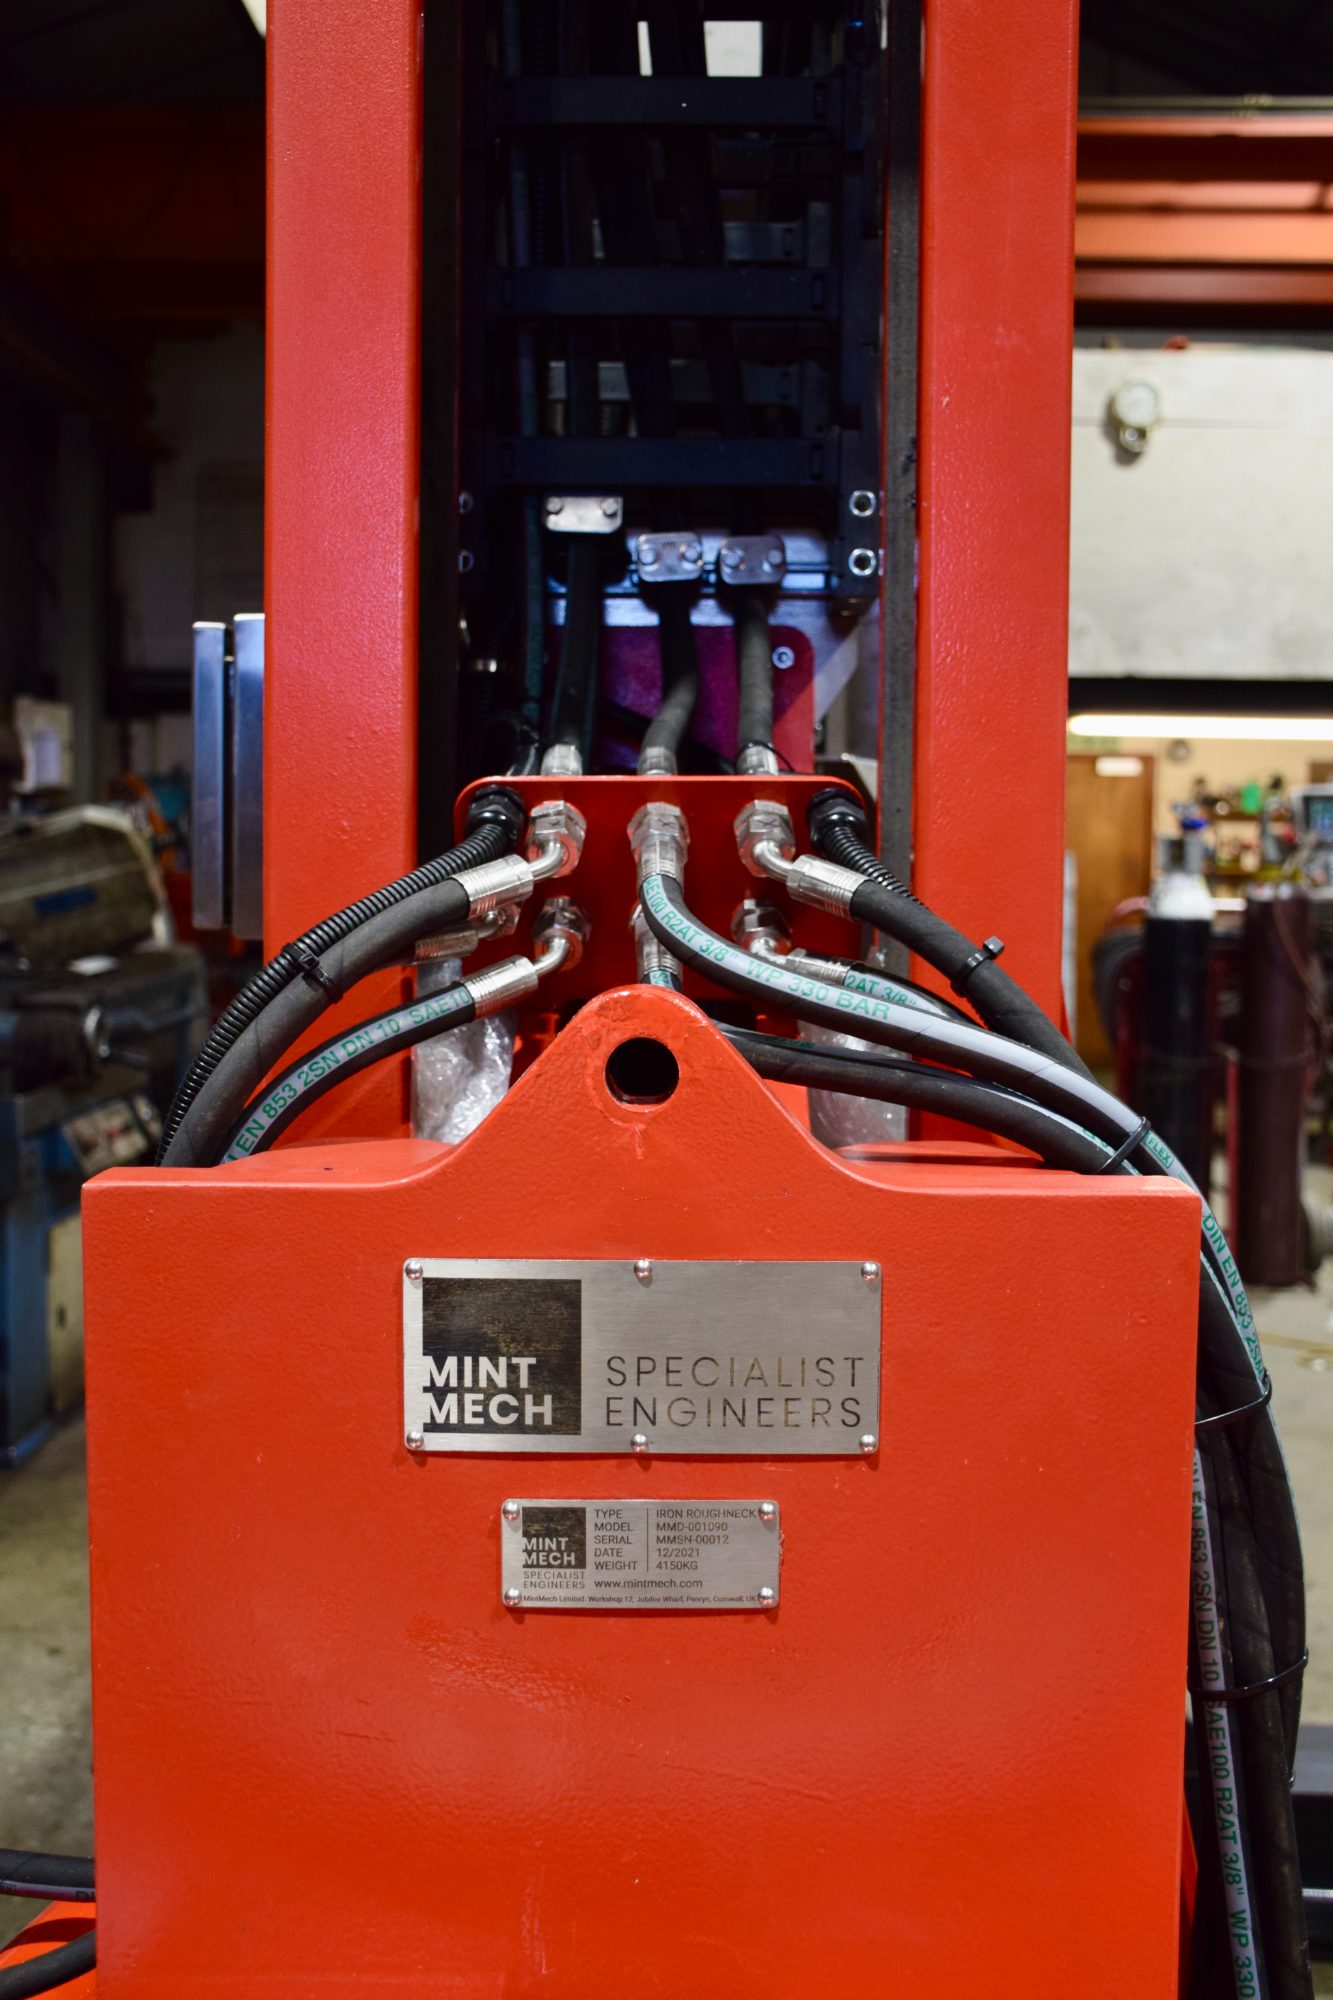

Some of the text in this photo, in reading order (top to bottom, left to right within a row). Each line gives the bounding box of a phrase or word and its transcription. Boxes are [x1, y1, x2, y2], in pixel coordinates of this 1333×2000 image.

[661, 911, 703, 943] R2AT
[745, 960, 784, 983] WP
[788, 977, 830, 1002] 330
[835, 991, 890, 1020] BAR
[235, 1119, 265, 1153] EN
[263, 1083, 297, 1118] 853
[297, 1051, 341, 1087] 2SN
[341, 1030, 374, 1057] DN
[376, 1018, 400, 1038] 10
[1147, 1137, 1171, 1164] FLEX
[1202, 1213, 1226, 1254] DIN
[1222, 1255, 1241, 1289] EN
[1235, 1290, 1253, 1330] 853
[423, 1356, 536, 1388] MINT
[606, 1356, 864, 1387] SPECIALIST
[423, 1394, 552, 1425] MECH
[606, 1397, 862, 1428] ENGINEERS
[594, 1508, 757, 1519] TYPE IRON ROUGHNECK
[594, 1521, 729, 1532] MODEL MMD-001090
[522, 1537, 569, 1550] MINT
[594, 1534, 730, 1545] SERIAL MMSN-00012
[594, 1547, 700, 1558] DATE 12/2021
[1191, 1527, 1208, 1563] 853
[522, 1552, 576, 1566] MECH
[594, 1560, 698, 1571] WEIGHT 4150KG
[523, 1570, 585, 1580] SPECIALIST
[523, 1580, 586, 1590] ENGINEERS
[594, 1578, 703, 1590] www.mintmech.com
[1194, 1570, 1213, 1612] 2SN
[1198, 1620, 1216, 1650] DN
[1201, 1659, 1220, 1682] 10
[1214, 1787, 1237, 1844] R2AT
[1229, 1909, 1249, 1948] WP
[1234, 1956, 1256, 1998] 330
